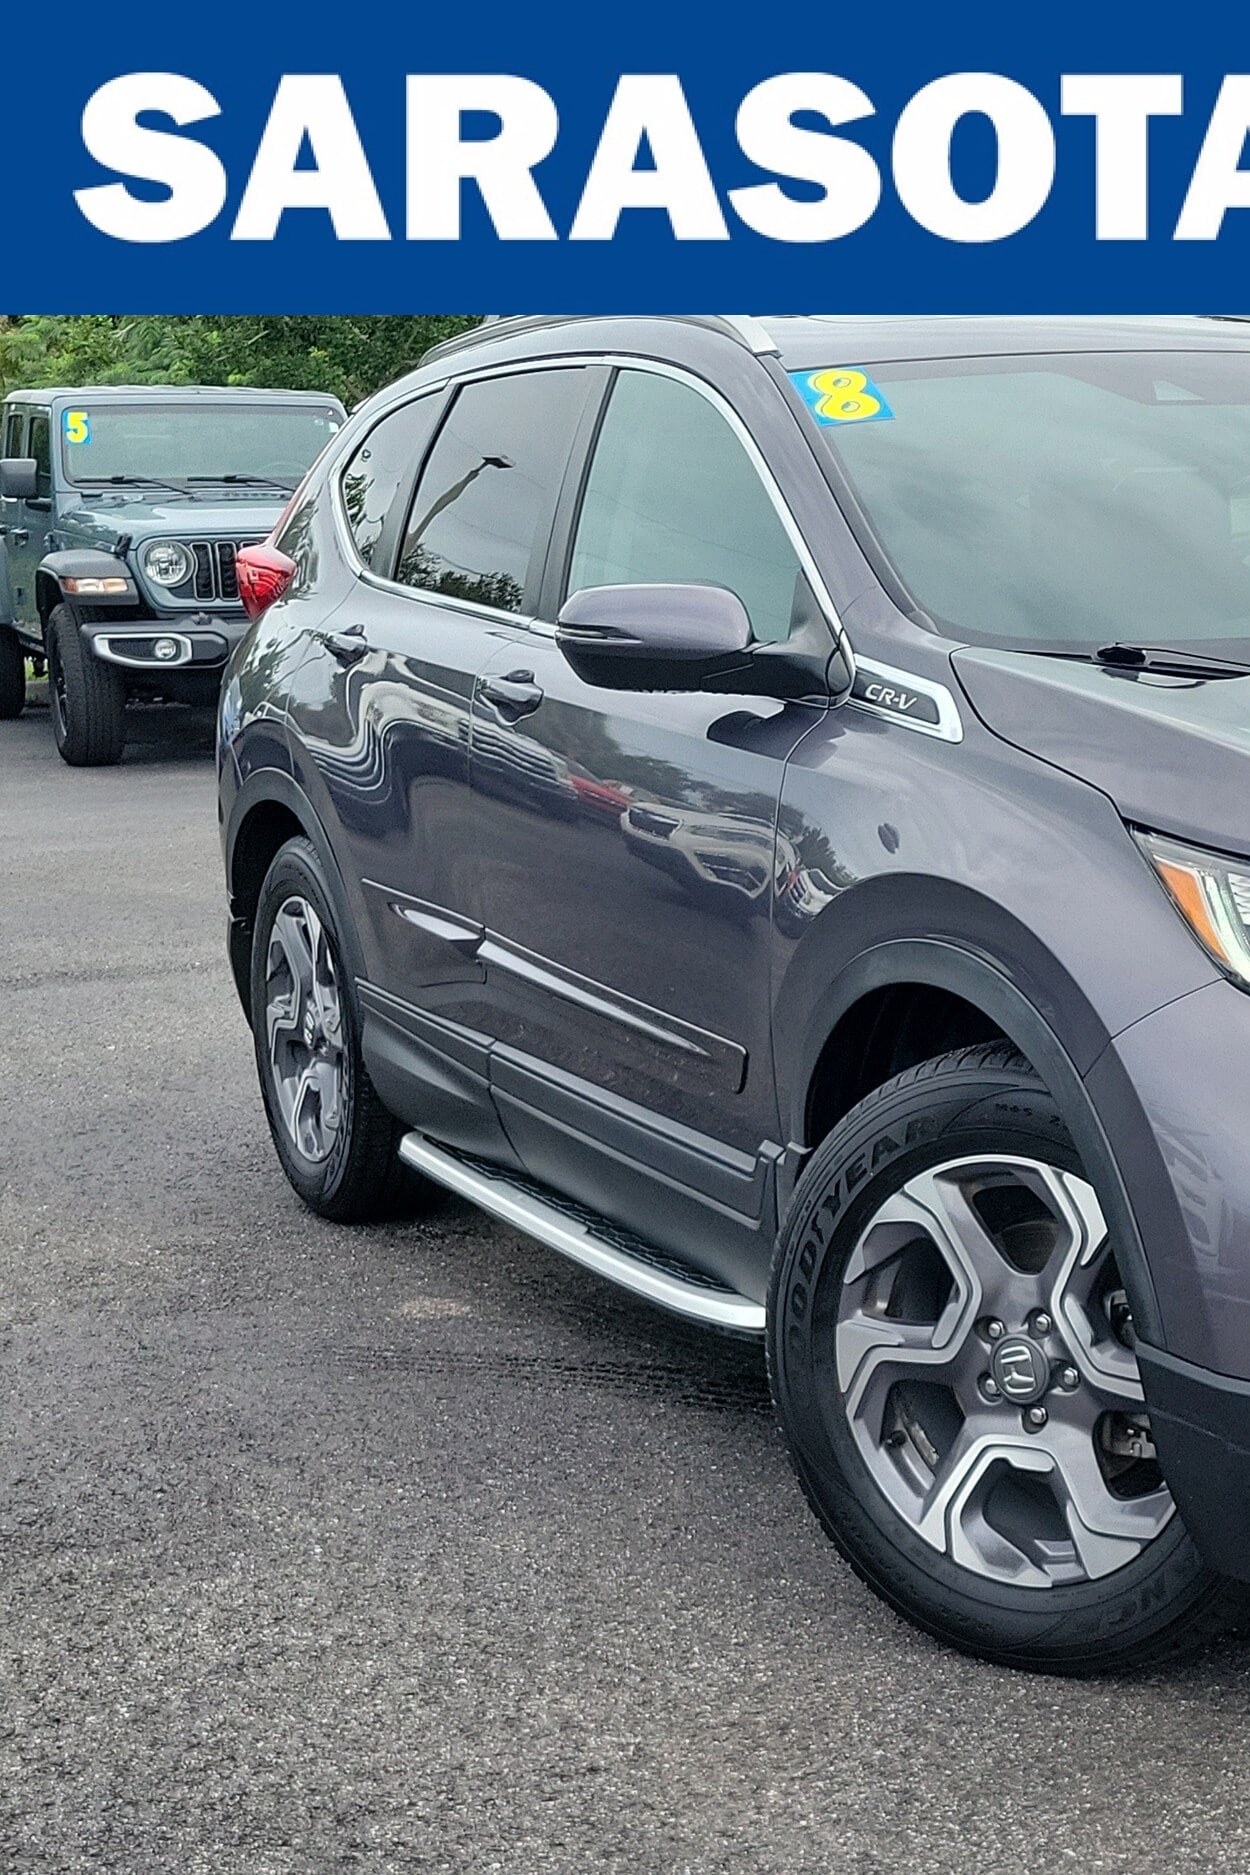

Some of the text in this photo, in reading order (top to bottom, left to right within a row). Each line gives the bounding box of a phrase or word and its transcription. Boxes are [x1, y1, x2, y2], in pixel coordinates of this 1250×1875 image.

[807, 369, 881, 420] 8
[66, 411, 88, 443] 5
[865, 684, 917, 710] CR-V
[787, 1115, 942, 1352] OODYEAR
